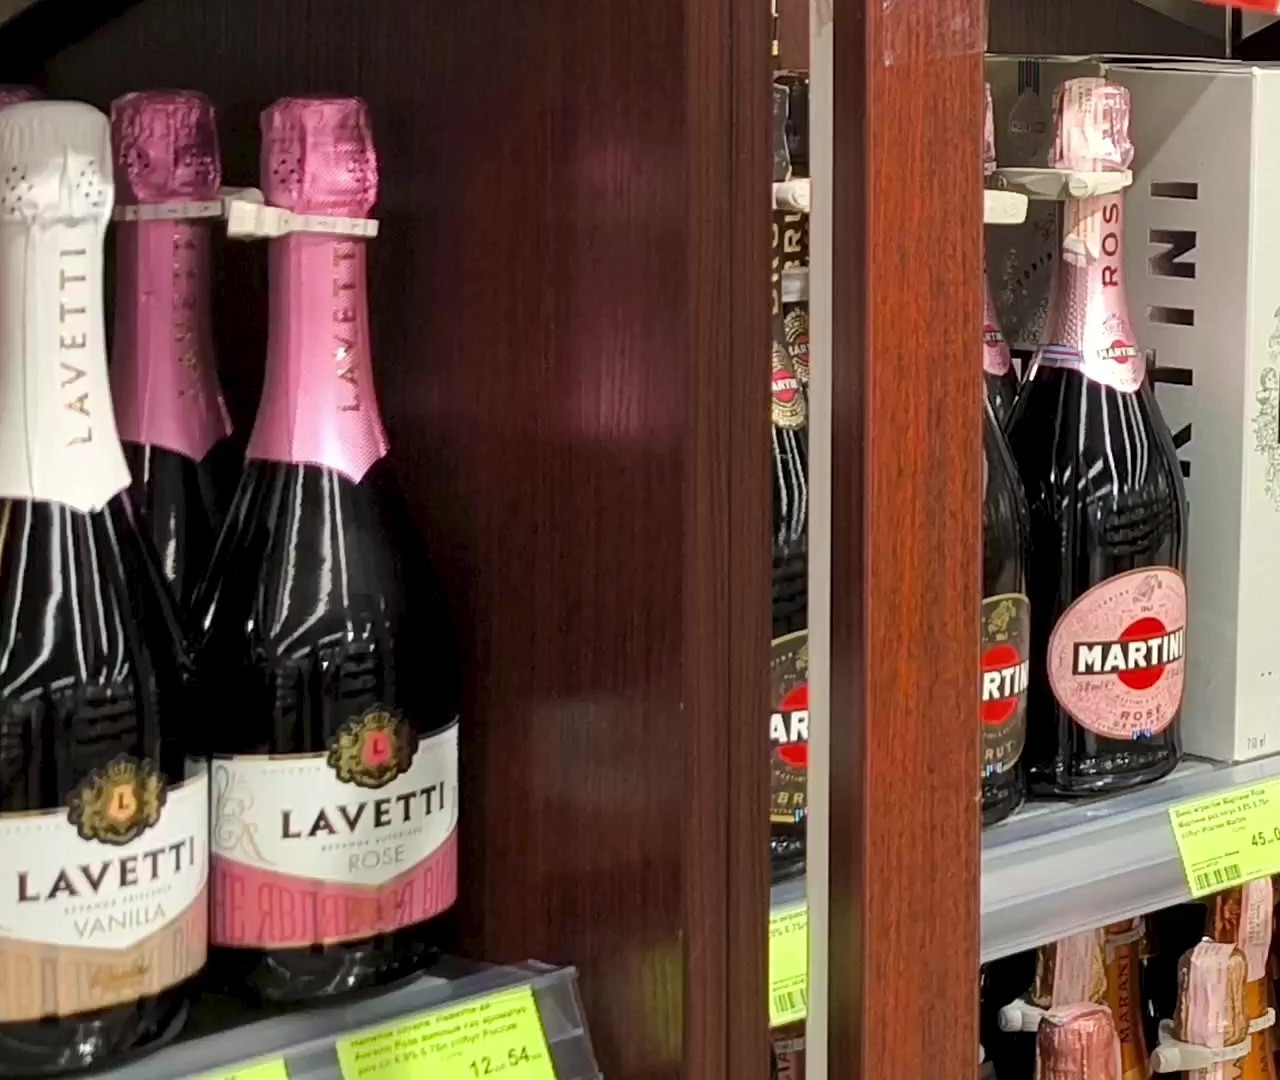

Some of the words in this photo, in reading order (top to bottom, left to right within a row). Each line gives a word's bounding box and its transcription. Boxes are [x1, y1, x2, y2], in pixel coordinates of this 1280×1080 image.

[1101, 202, 1119, 288] ROS
[59, 248, 94, 448] LAVETTI
[332, 240, 361, 413] LAVETT
[1077, 629, 1184, 673] MARTINI
[281, 780, 445, 840] LAVETTI
[1251, 830, 1267, 847] 45
[17, 835, 195, 904] LAVETTI
[74, 902, 167, 940] VANILLA
[1119, 954, 1132, 1045] MARANI
[468, 1055, 494, 1078] 12
[508, 1045, 531, 1067] 54
